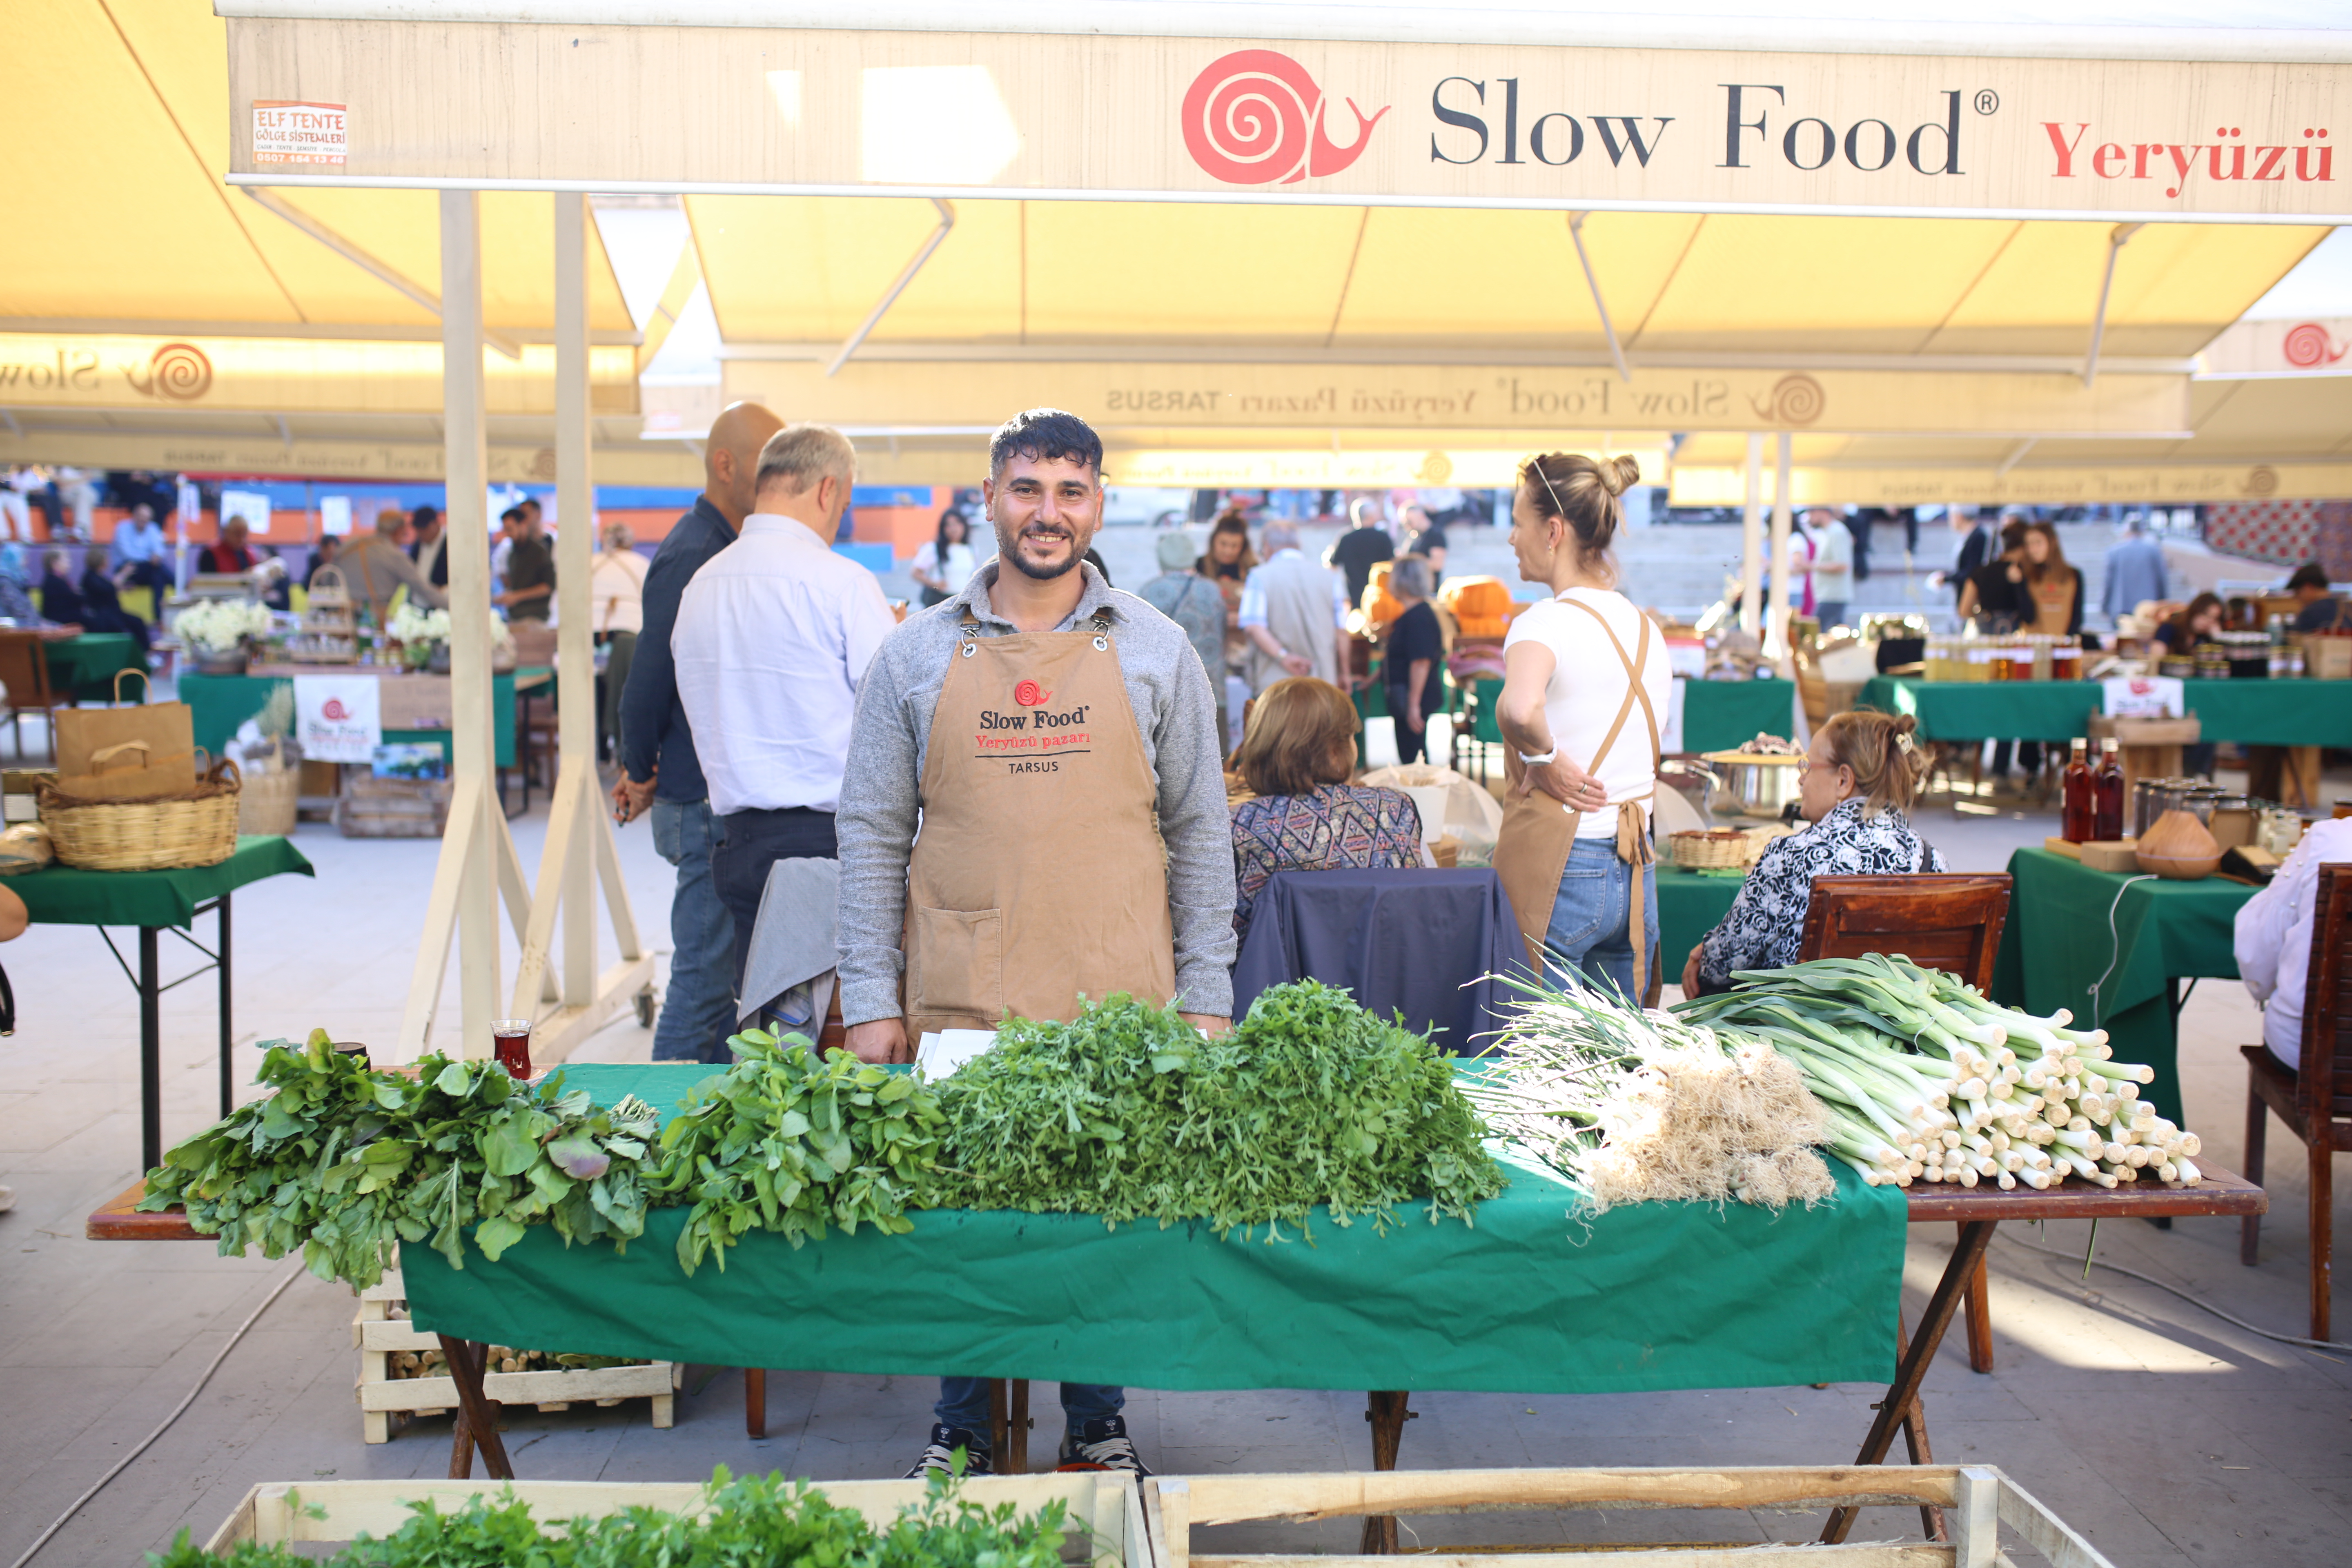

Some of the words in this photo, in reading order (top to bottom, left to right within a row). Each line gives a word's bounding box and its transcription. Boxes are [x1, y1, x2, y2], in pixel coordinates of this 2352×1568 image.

[257, 111, 286, 127] ELF
[290, 112, 345, 130] TENTE
[256, 128, 286, 141] GÖLGE
[289, 129, 345, 144] SİSTEMLERİ
[1431, 76, 1675, 168] Slow
[2040, 122, 2336, 198] Yeryüzü
[256, 153, 285, 162] 0507
[289, 154, 310, 163] 154
[980, 710, 1027, 730] Slow
[975, 735, 1038, 751] Yeryüzü
[1042, 733, 1091, 750] pazarı
[1009, 761, 1059, 774] TARSUS
